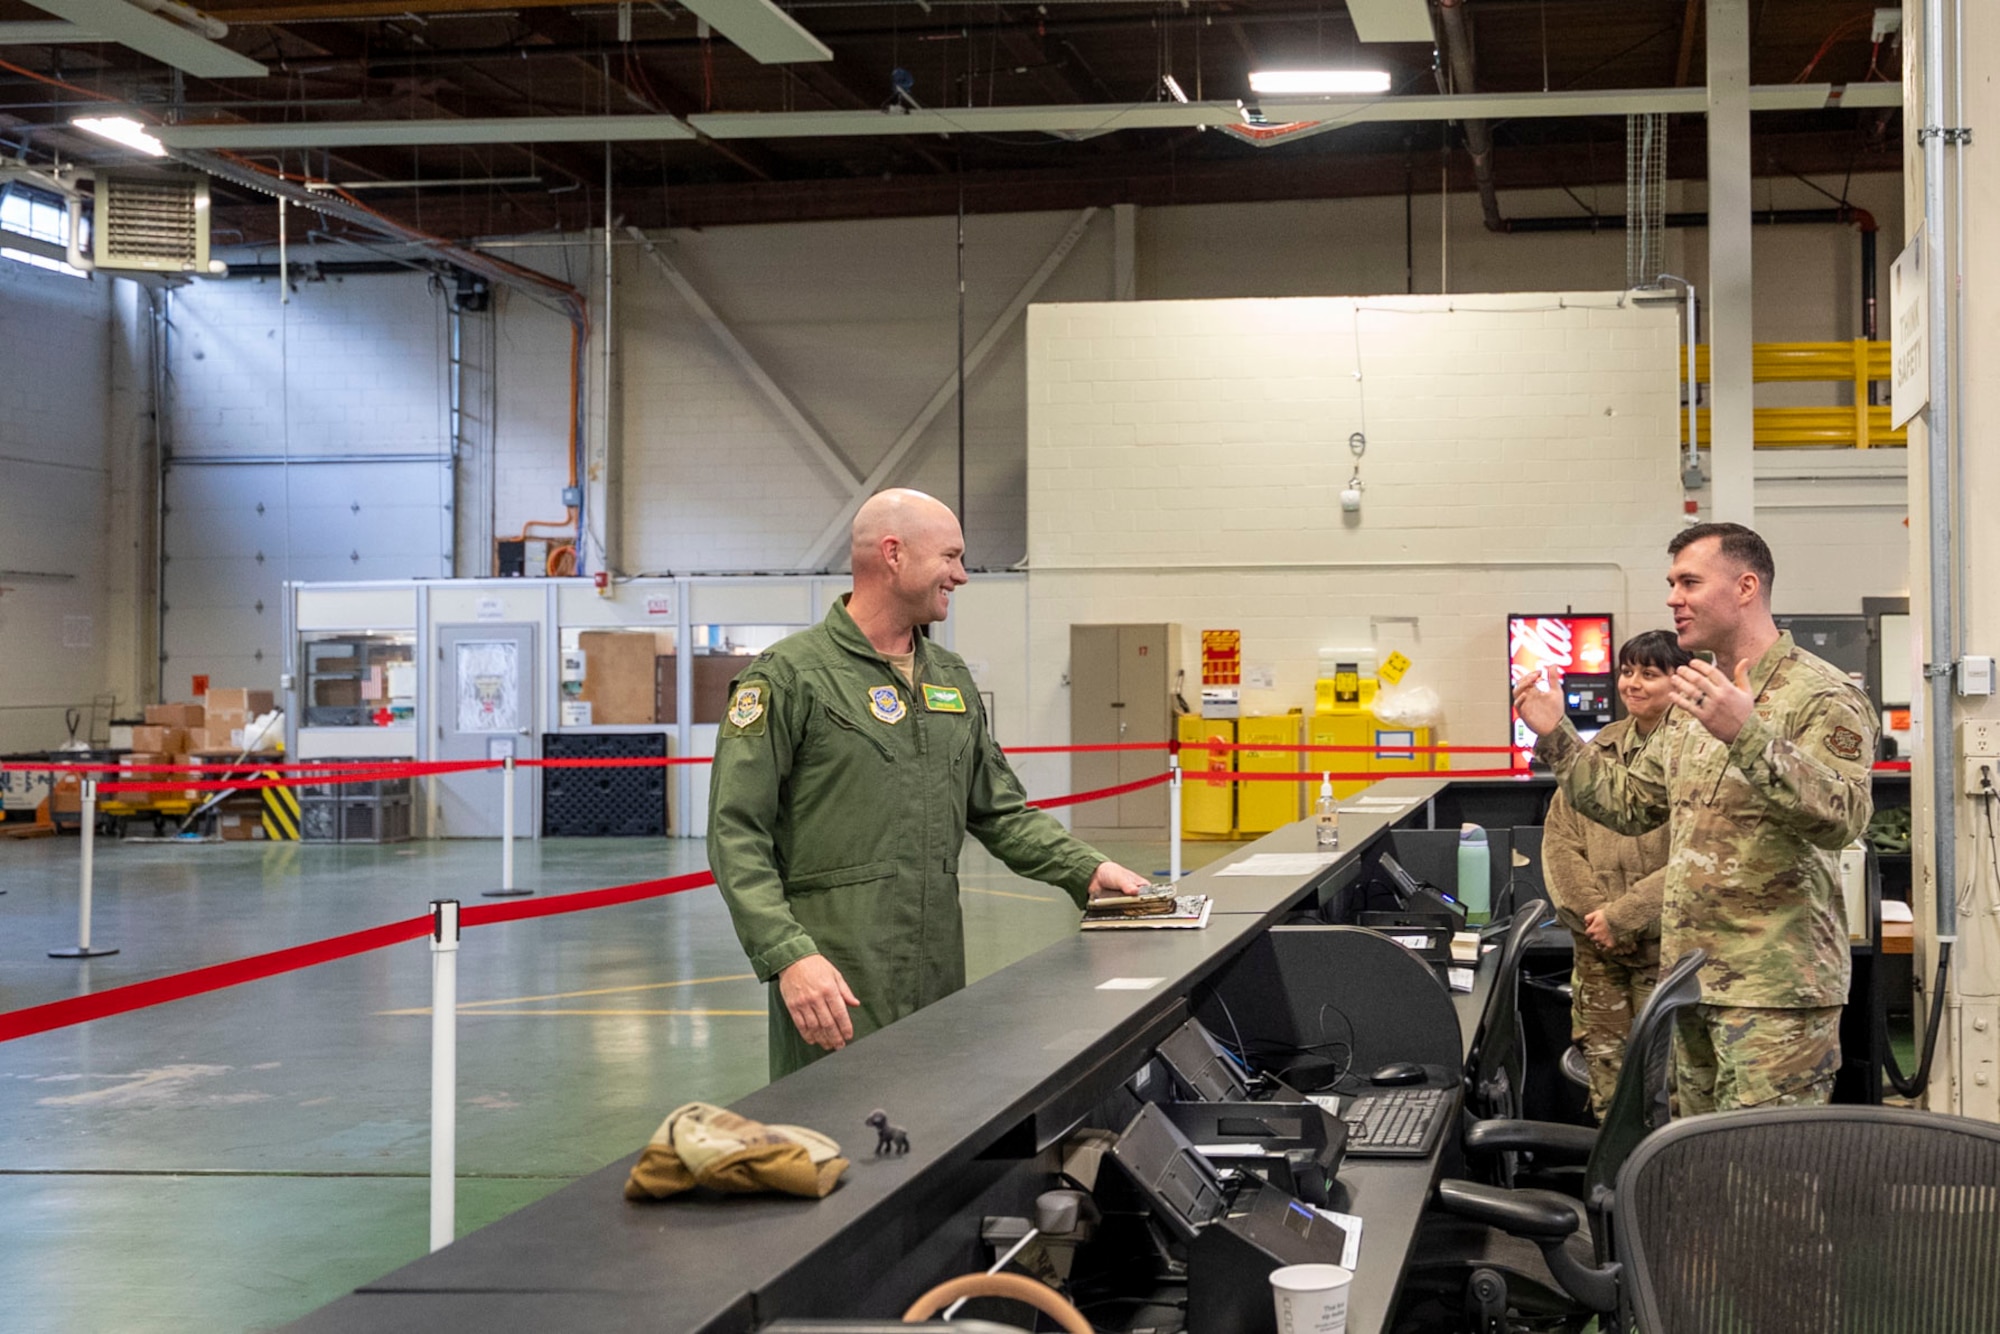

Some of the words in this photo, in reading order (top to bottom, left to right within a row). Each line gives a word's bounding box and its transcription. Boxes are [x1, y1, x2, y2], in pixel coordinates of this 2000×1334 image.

[1899, 295, 1920, 345] THINK
[1897, 335, 1922, 388] SAFETY
[648, 600, 668, 609] EXIT
